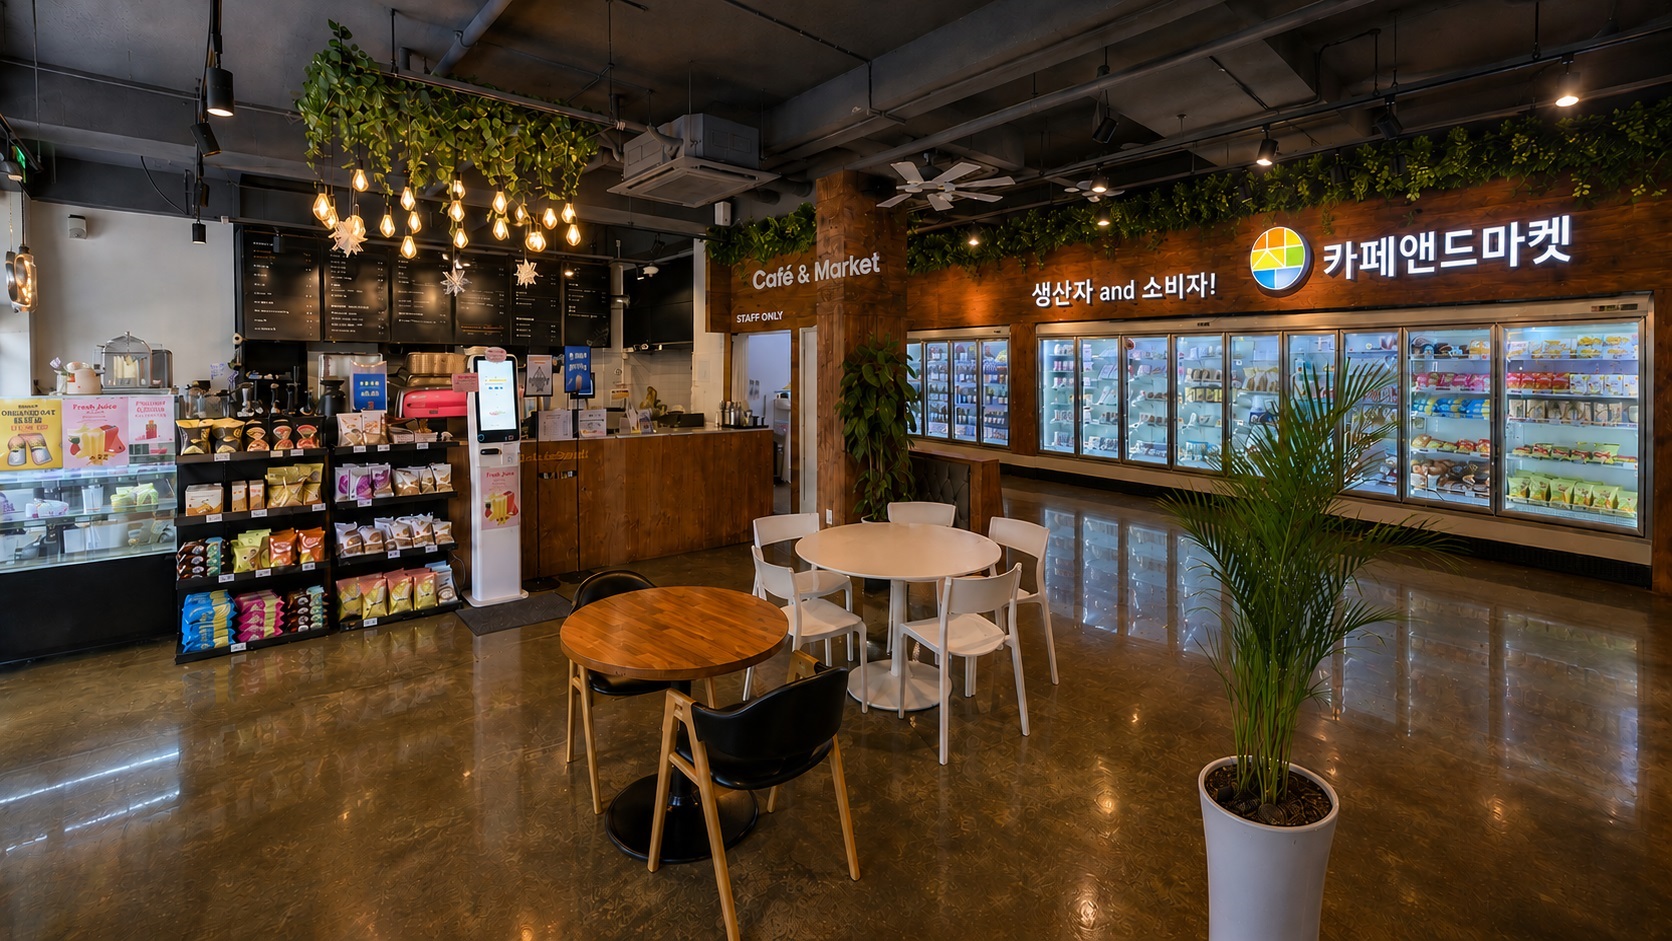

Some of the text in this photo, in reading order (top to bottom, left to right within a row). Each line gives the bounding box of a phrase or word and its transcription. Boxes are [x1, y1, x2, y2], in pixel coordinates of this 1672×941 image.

[1323, 214, 1571, 280] 카페앤드마켓
[753, 252, 881, 290] Café & Market
[1031, 271, 1215, 307] 생산자 and 소비자!
[736, 311, 783, 323] STAFF ONLY
